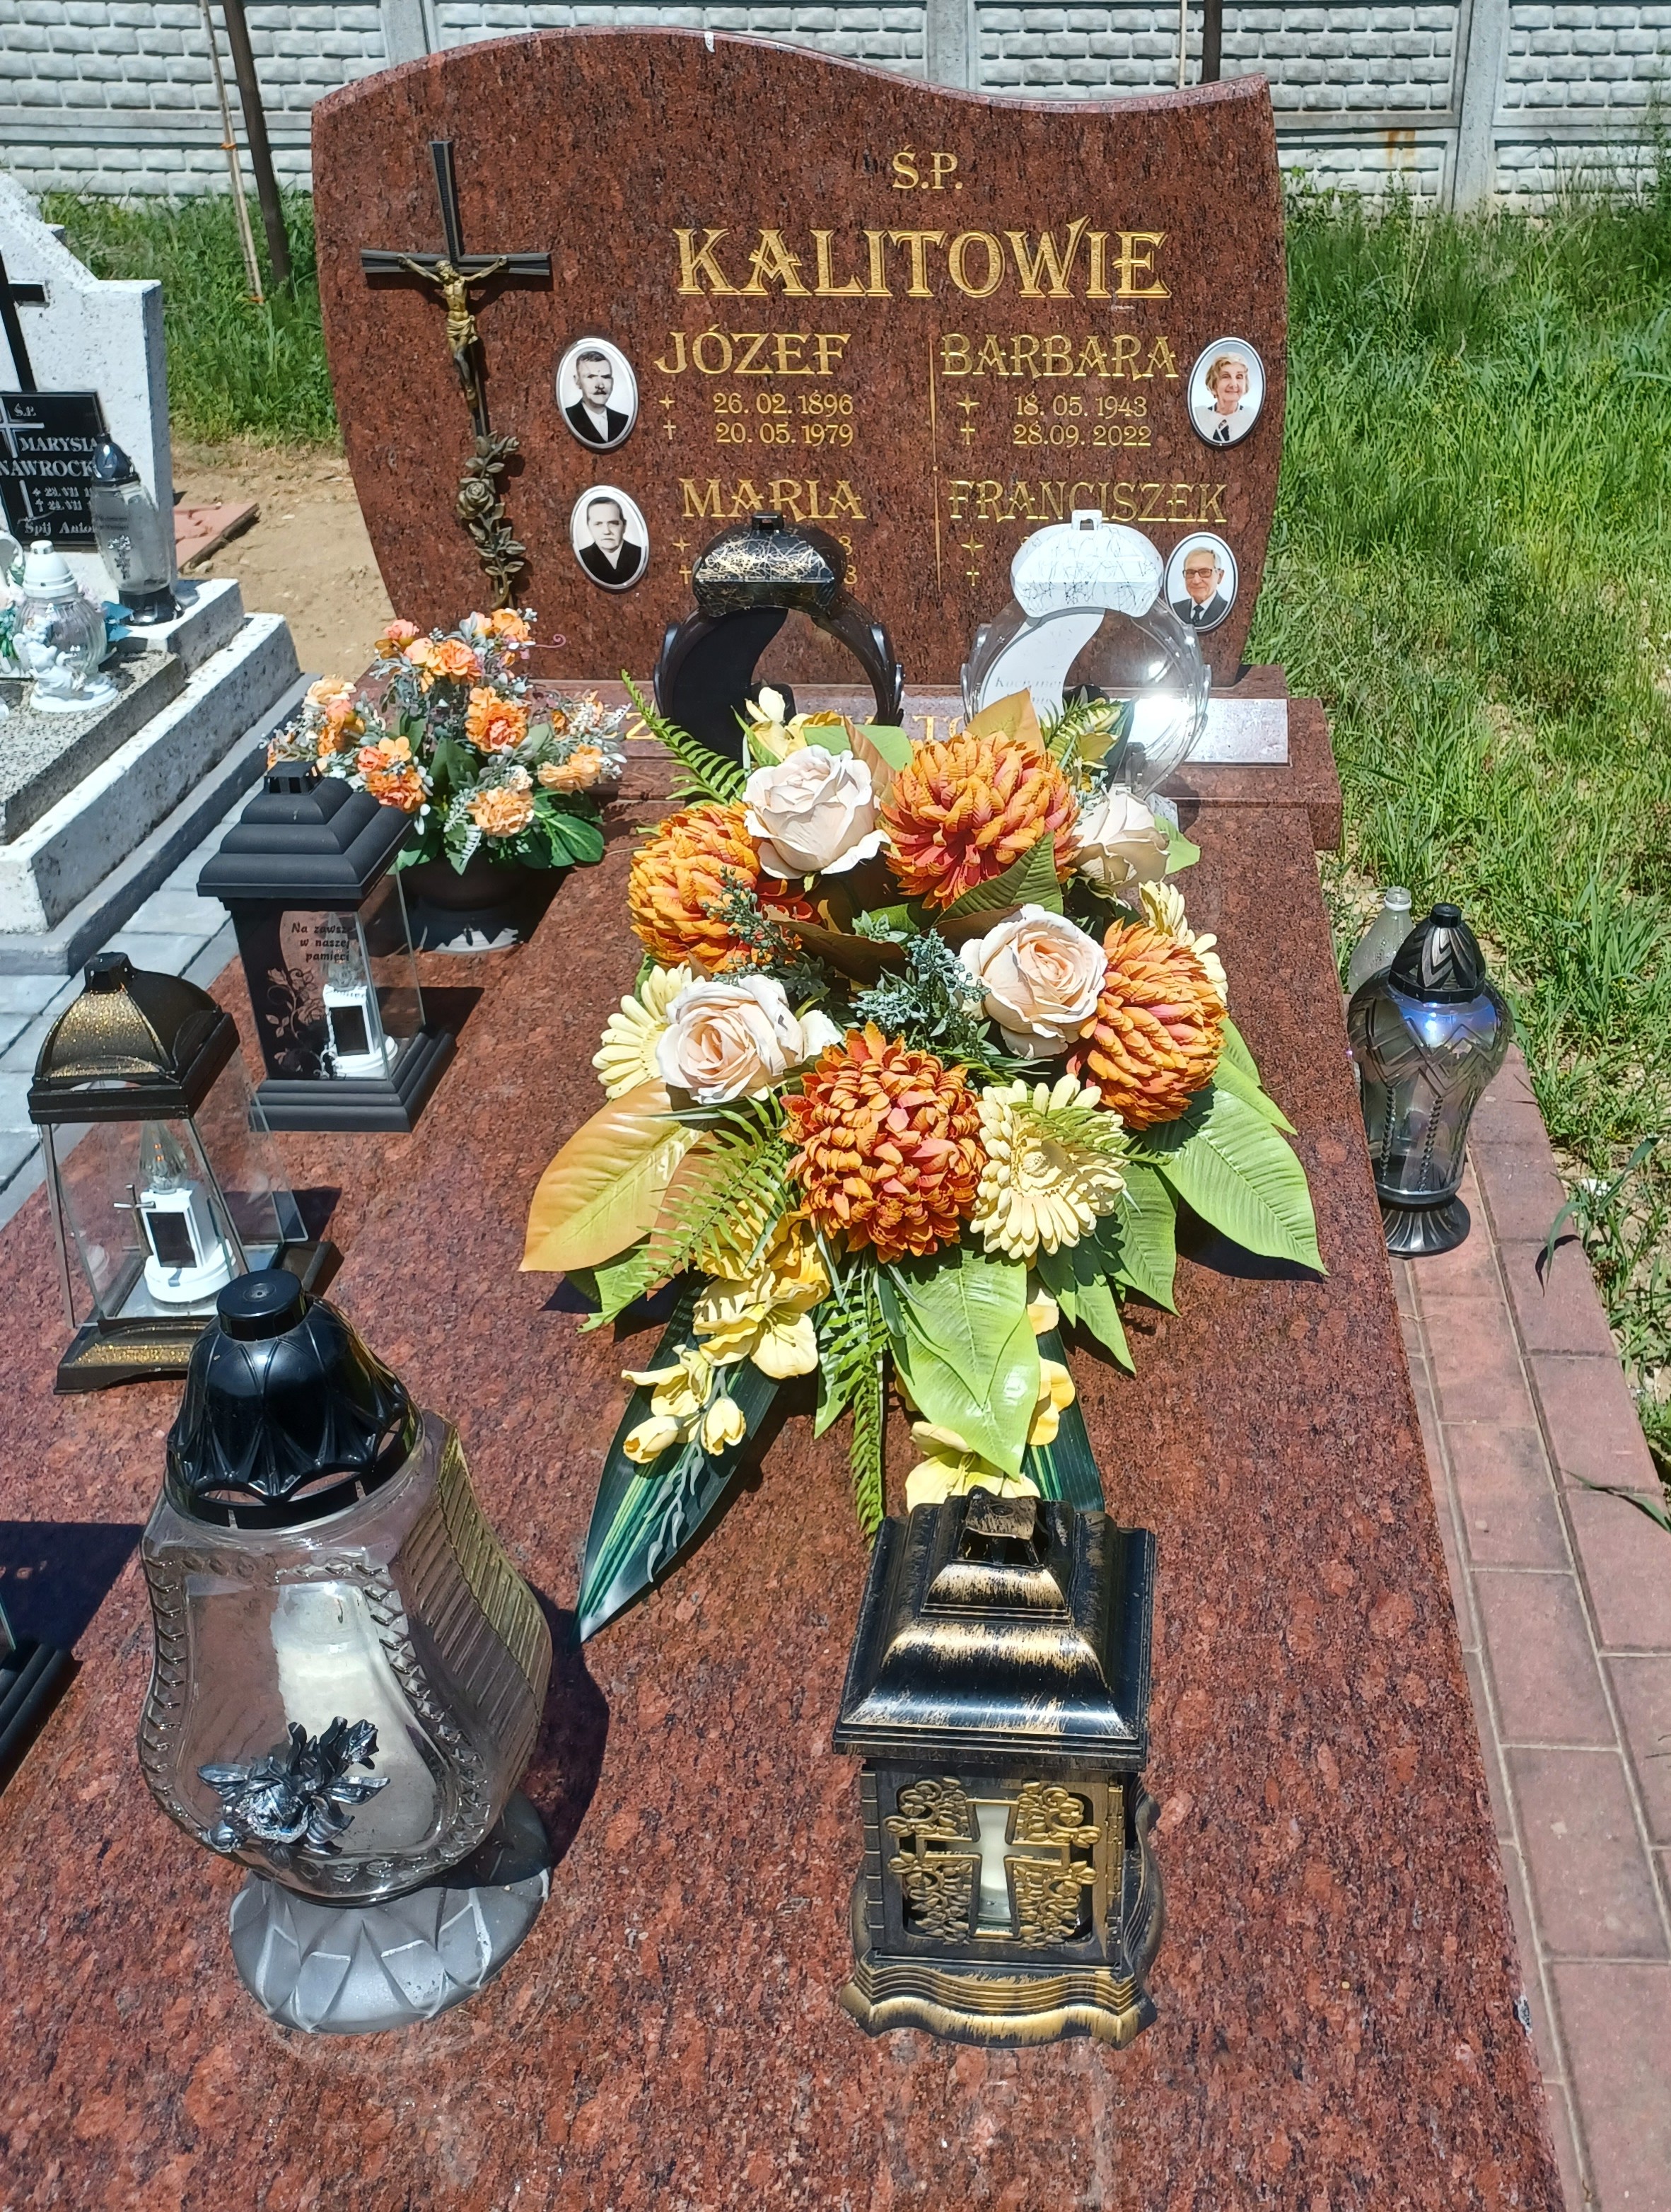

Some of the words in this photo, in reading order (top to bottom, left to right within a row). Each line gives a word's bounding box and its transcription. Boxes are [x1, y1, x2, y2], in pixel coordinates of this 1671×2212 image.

[892, 145, 963, 190] Ś.P.
[673, 214, 1172, 298] KALITOWIE
[653, 324, 851, 375] JÓZEF
[940, 333, 1179, 380] BARBARA
[798, 390, 854, 417] 1896
[1095, 395, 1147, 419] 1943
[800, 424, 854, 447] 1979
[1093, 425, 1152, 446] 2022
[0, 459, 93, 477] NAWROCK
[679, 478, 867, 521] MARIA
[948, 479, 1228, 522] FRANCISZEK
[291, 921, 308, 933] Na
[305, 950, 349, 963] pamięci
[315, 940, 349, 949] naszej
